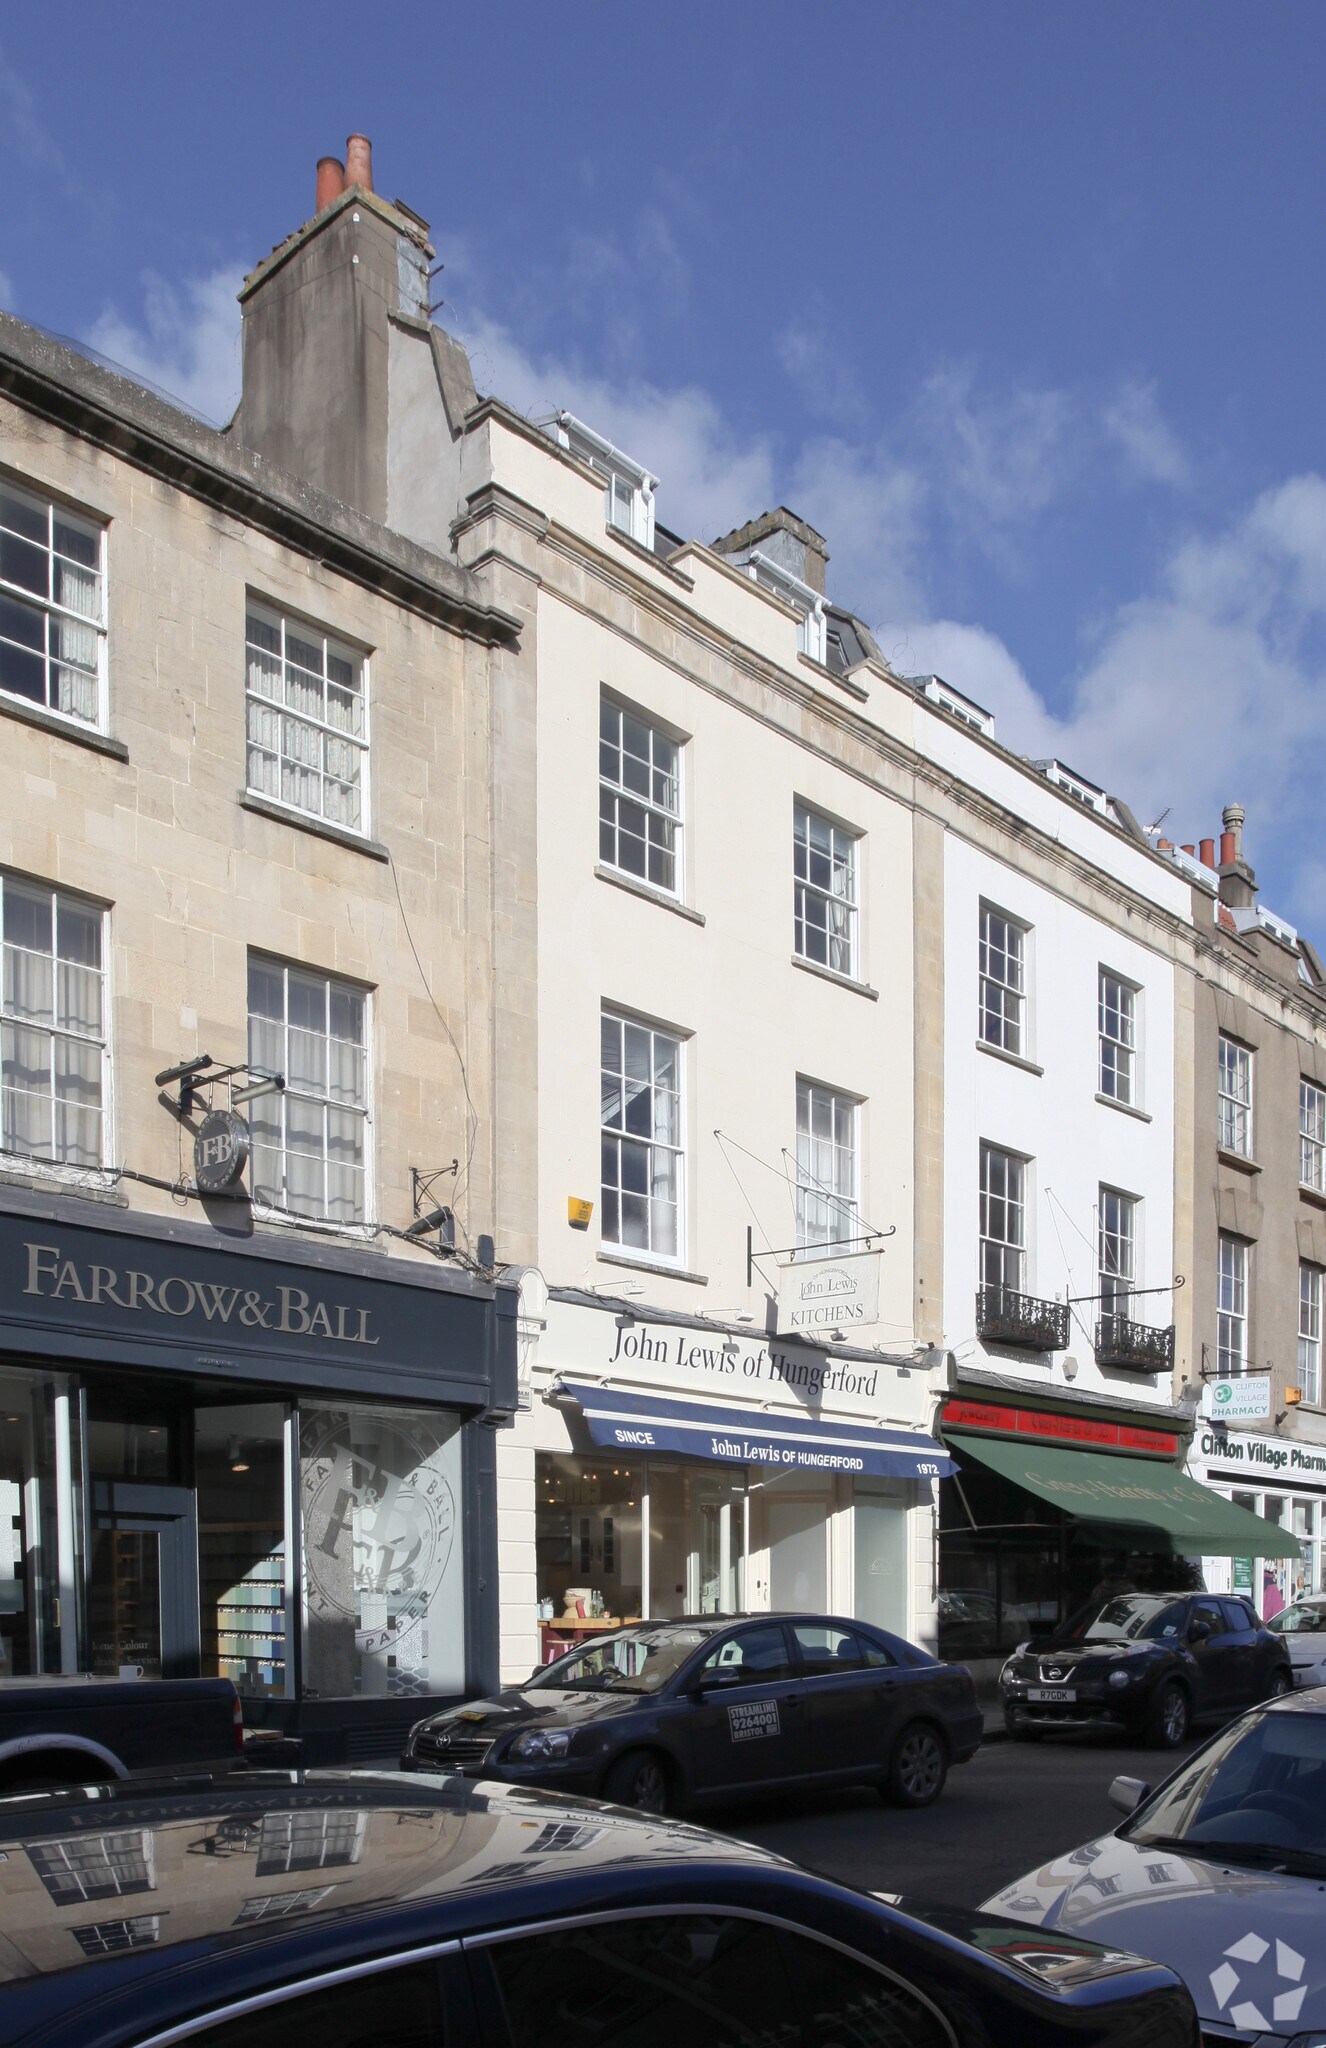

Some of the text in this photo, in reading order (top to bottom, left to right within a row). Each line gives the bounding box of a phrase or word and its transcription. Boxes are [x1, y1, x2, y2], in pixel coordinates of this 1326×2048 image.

[798, 1277, 858, 1299] John Lewis
[790, 1303, 864, 1326] KITCHENS
[609, 1325, 880, 1397] John Lewis of Hungerford
[1235, 1382, 1268, 1391] CLIFTON
[1235, 1394, 1268, 1402] VILLAGE
[1212, 1406, 1268, 1417] PHARMACY
[615, 1429, 656, 1445] SINCE
[711, 1438, 864, 1470] John Lewis OF HUNGERFORD
[1201, 1433, 1244, 1460] Clifton
[1247, 1441, 1288, 1470] Village
[916, 1463, 940, 1475] 1972
[119, 1639, 150, 1650] Colour
[126, 1655, 159, 1666] Service
[730, 1702, 775, 1719] STREAMLINE
[732, 1712, 777, 1730] 9264001
[733, 1726, 764, 1739] BRISTOL
